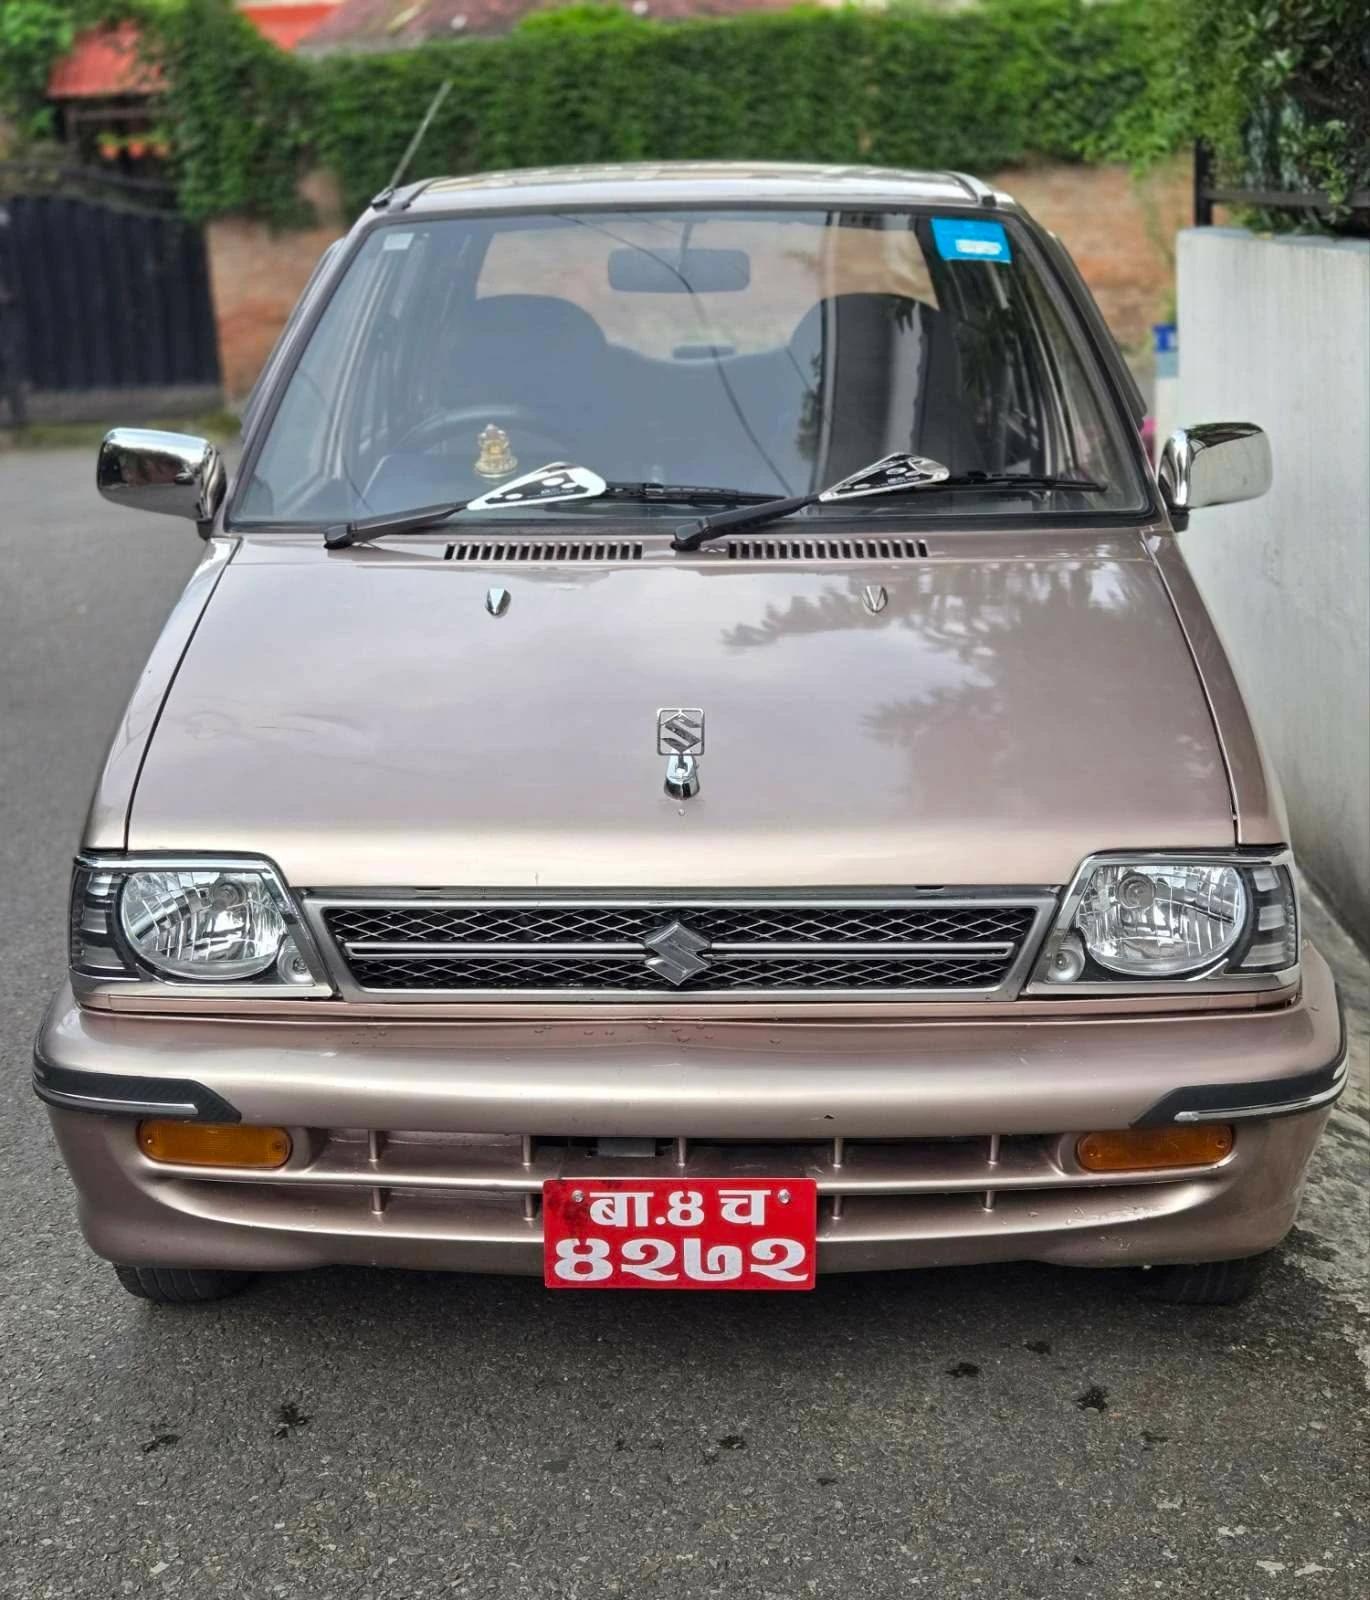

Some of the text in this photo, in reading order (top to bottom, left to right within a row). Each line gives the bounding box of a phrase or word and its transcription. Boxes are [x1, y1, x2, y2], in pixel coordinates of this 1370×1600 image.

[589, 1189, 771, 1227] बा.४ च
[554, 1237, 809, 1282] ४२७२
